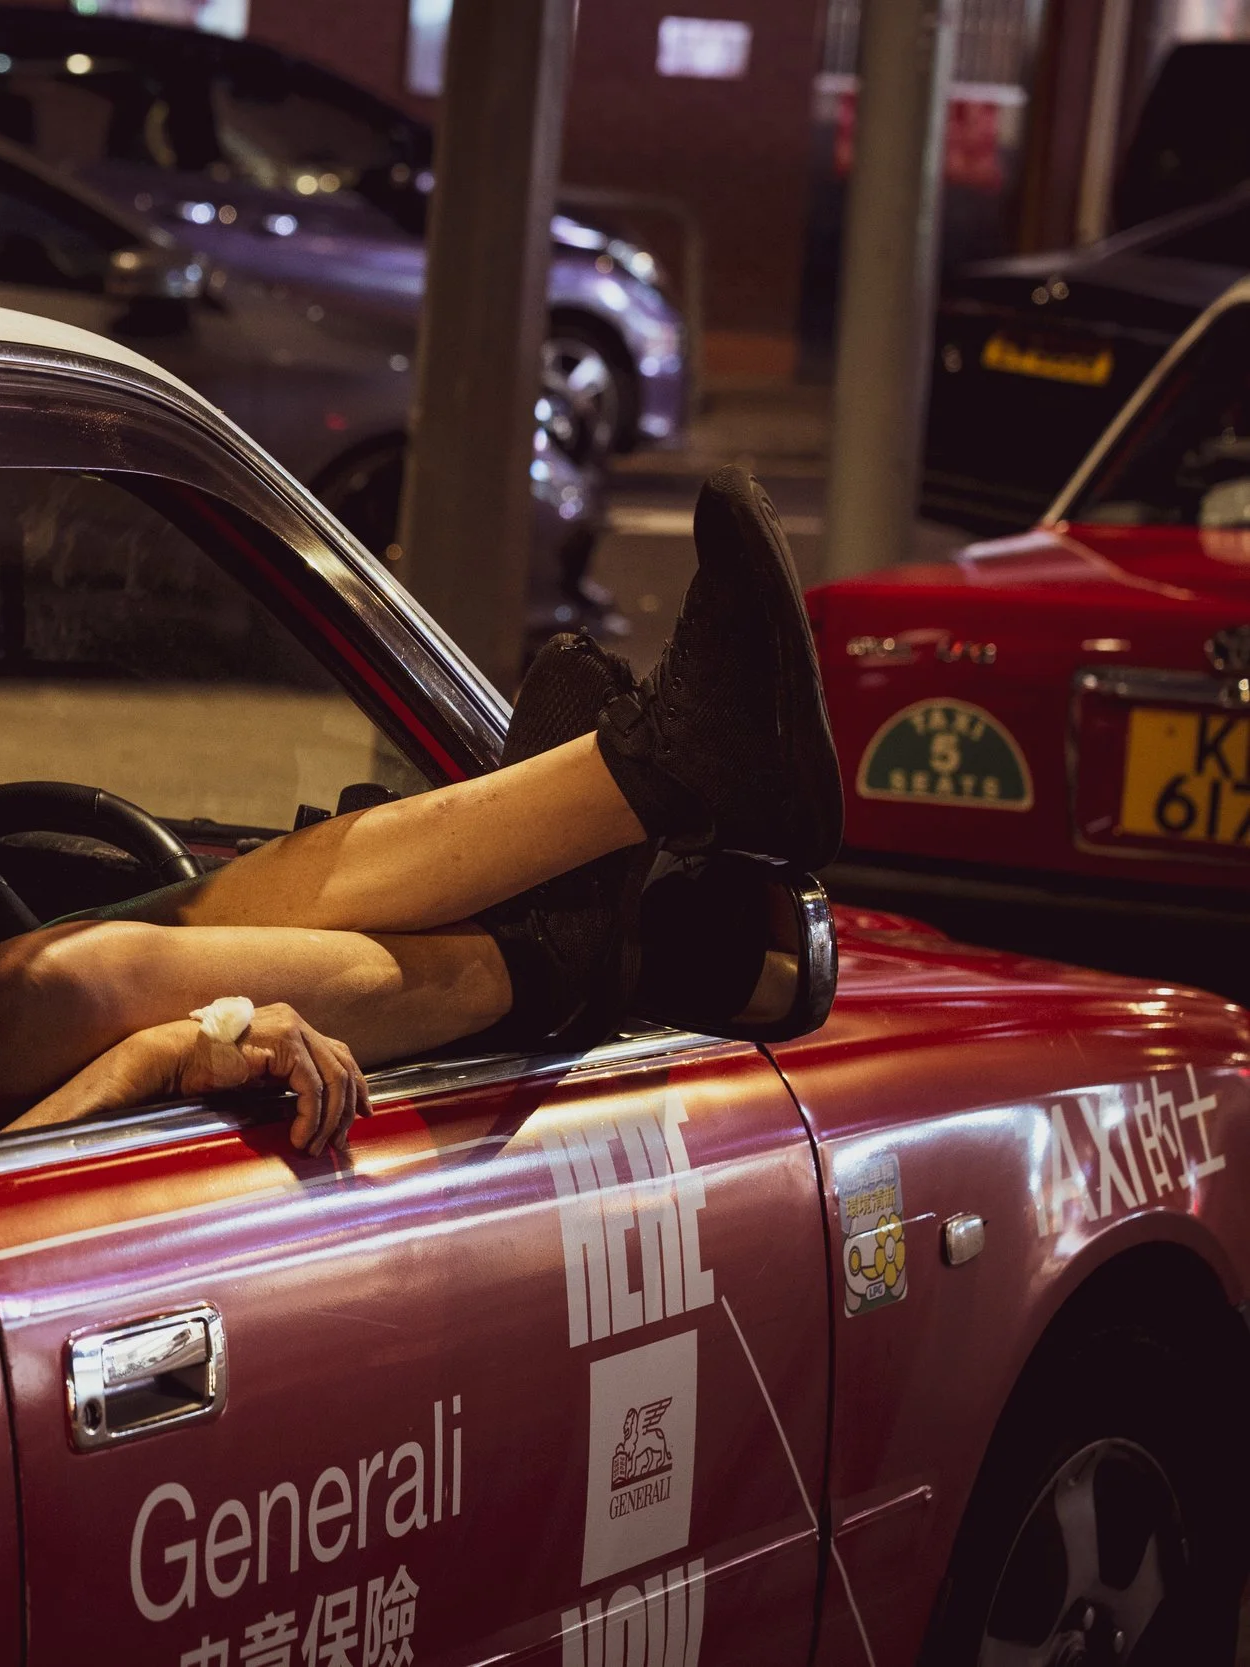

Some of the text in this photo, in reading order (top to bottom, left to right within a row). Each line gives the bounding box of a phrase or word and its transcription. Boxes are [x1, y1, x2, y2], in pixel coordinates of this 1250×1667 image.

[928, 730, 963, 776] 5
[1195, 709, 1250, 777] K
[1134, 1063, 1227, 1198] 的士
[541, 1087, 715, 1349] HERE
[868, 1283, 884, 1299] LPG
[130, 1395, 462, 1622] Generali
[609, 1475, 673, 1521] GENERALI
